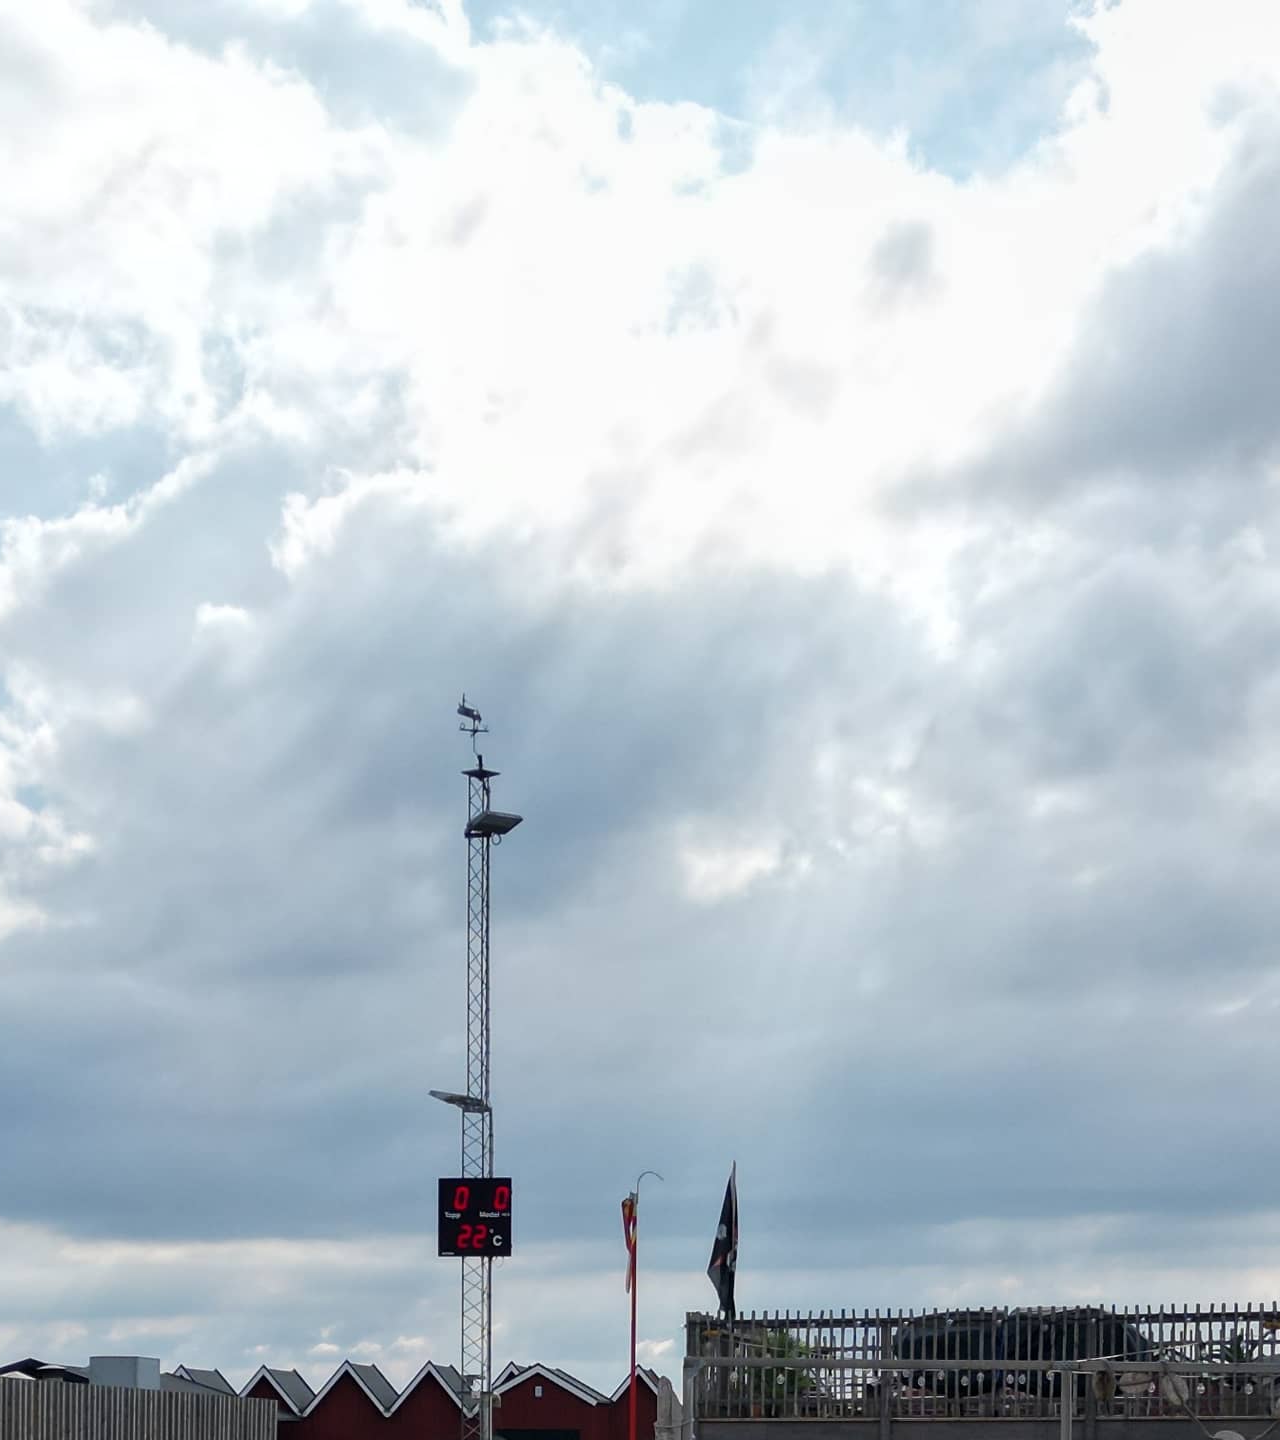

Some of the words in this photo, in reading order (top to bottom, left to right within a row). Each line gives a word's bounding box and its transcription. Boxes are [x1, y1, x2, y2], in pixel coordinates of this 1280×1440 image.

[453, 1185, 470, 1211] 0
[493, 1185, 510, 1211] 0
[456, 1223, 488, 1249] 22
